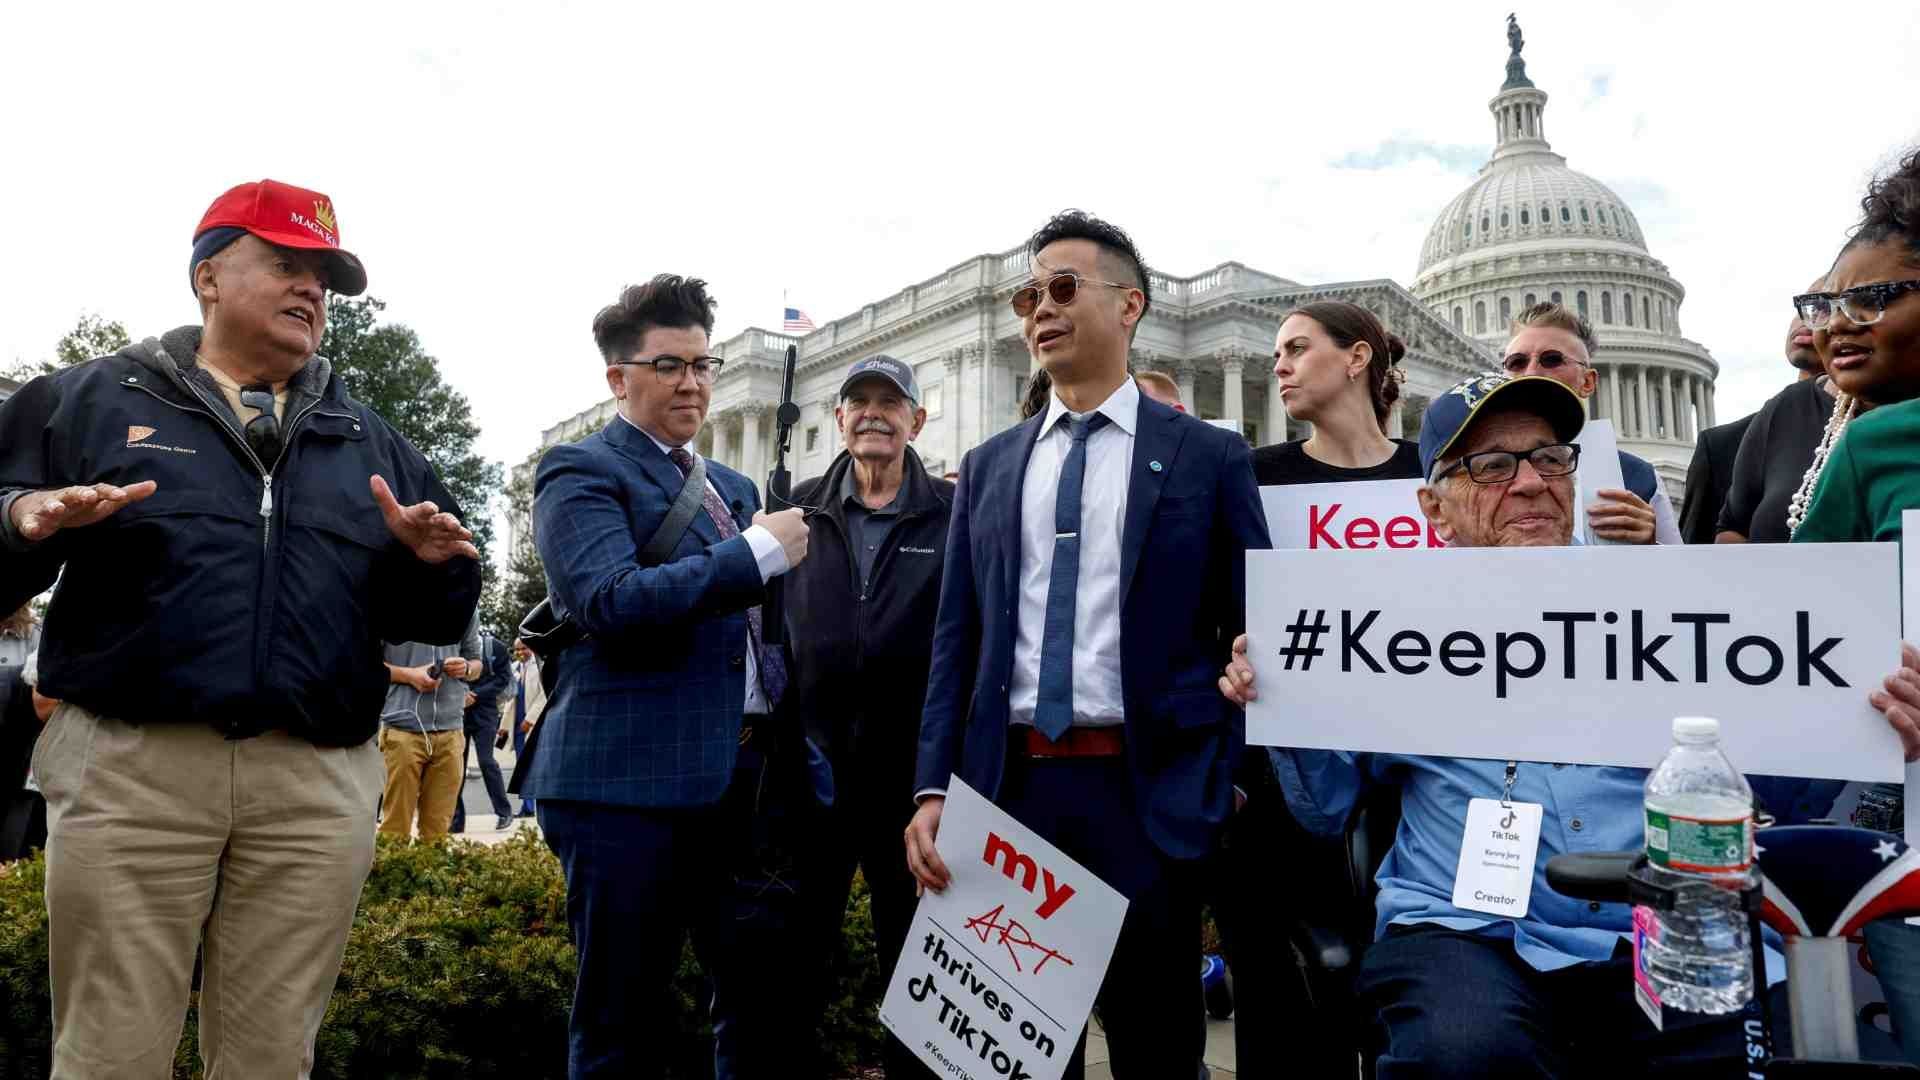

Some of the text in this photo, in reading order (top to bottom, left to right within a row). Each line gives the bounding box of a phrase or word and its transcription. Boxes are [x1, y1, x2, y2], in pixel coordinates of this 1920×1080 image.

[290, 211, 325, 240] MAGA
[1279, 608, 1852, 699] #KeepTikTok
[1491, 830, 1520, 842] TikTok
[983, 831, 1076, 920] my
[1474, 890, 1518, 906] Creator
[964, 904, 1074, 975] ART
[922, 933, 1055, 1058] thrives on
[925, 1041, 975, 1080] #KeepTik
[936, 995, 1032, 1080] TikTok
